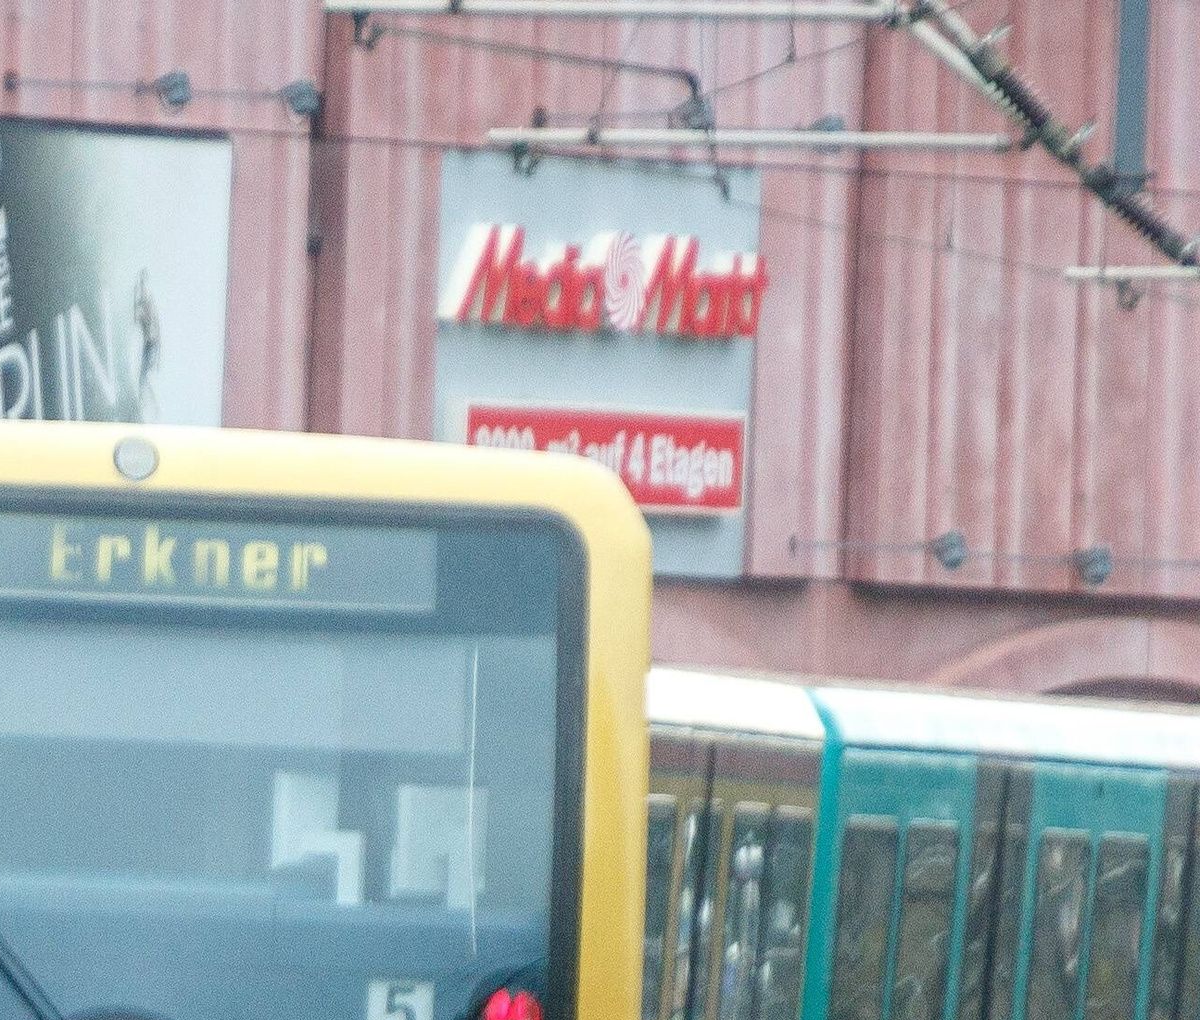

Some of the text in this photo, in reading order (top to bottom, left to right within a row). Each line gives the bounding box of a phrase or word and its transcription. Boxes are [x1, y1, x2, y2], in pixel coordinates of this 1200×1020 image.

[450, 224, 606, 334] Media
[629, 432, 646, 484] 4
[651, 434, 735, 498] Etagen
